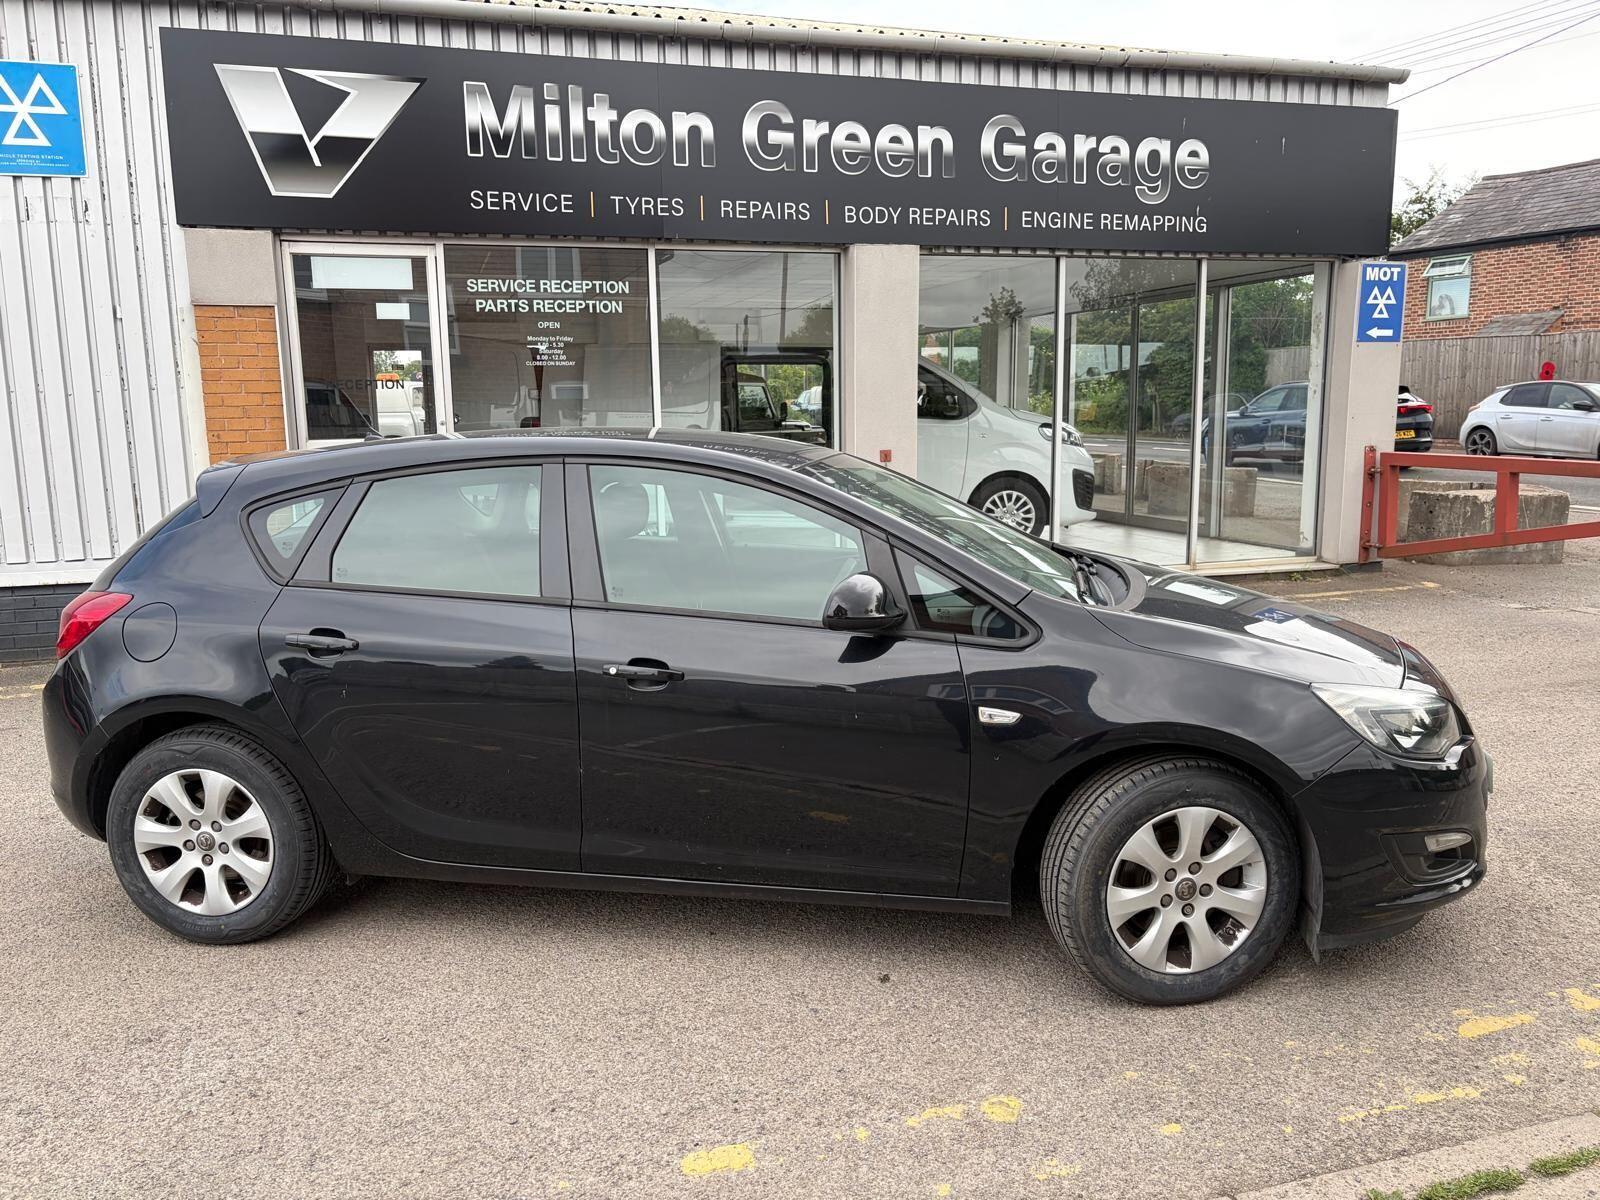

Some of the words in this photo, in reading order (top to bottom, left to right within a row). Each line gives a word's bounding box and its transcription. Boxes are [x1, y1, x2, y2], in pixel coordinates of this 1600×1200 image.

[463, 81, 716, 167] Milton
[742, 100, 956, 178] Green
[980, 114, 1210, 204] Garage
[470, 190, 573, 213] SERVICE
[610, 195, 684, 217] TYRES
[721, 199, 811, 221] REPAIRS
[844, 205, 902, 225] BODY
[909, 207, 991, 227] REPAIRS
[1022, 211, 1094, 230] ENGINE
[1100, 213, 1207, 233] REMAPPING
[1366, 267, 1401, 281] MOT
[466, 278, 536, 293] SERVICE
[540, 279, 630, 294] RECEPTION
[475, 299, 530, 313] PARTS
[533, 299, 623, 314] RECEPTION
